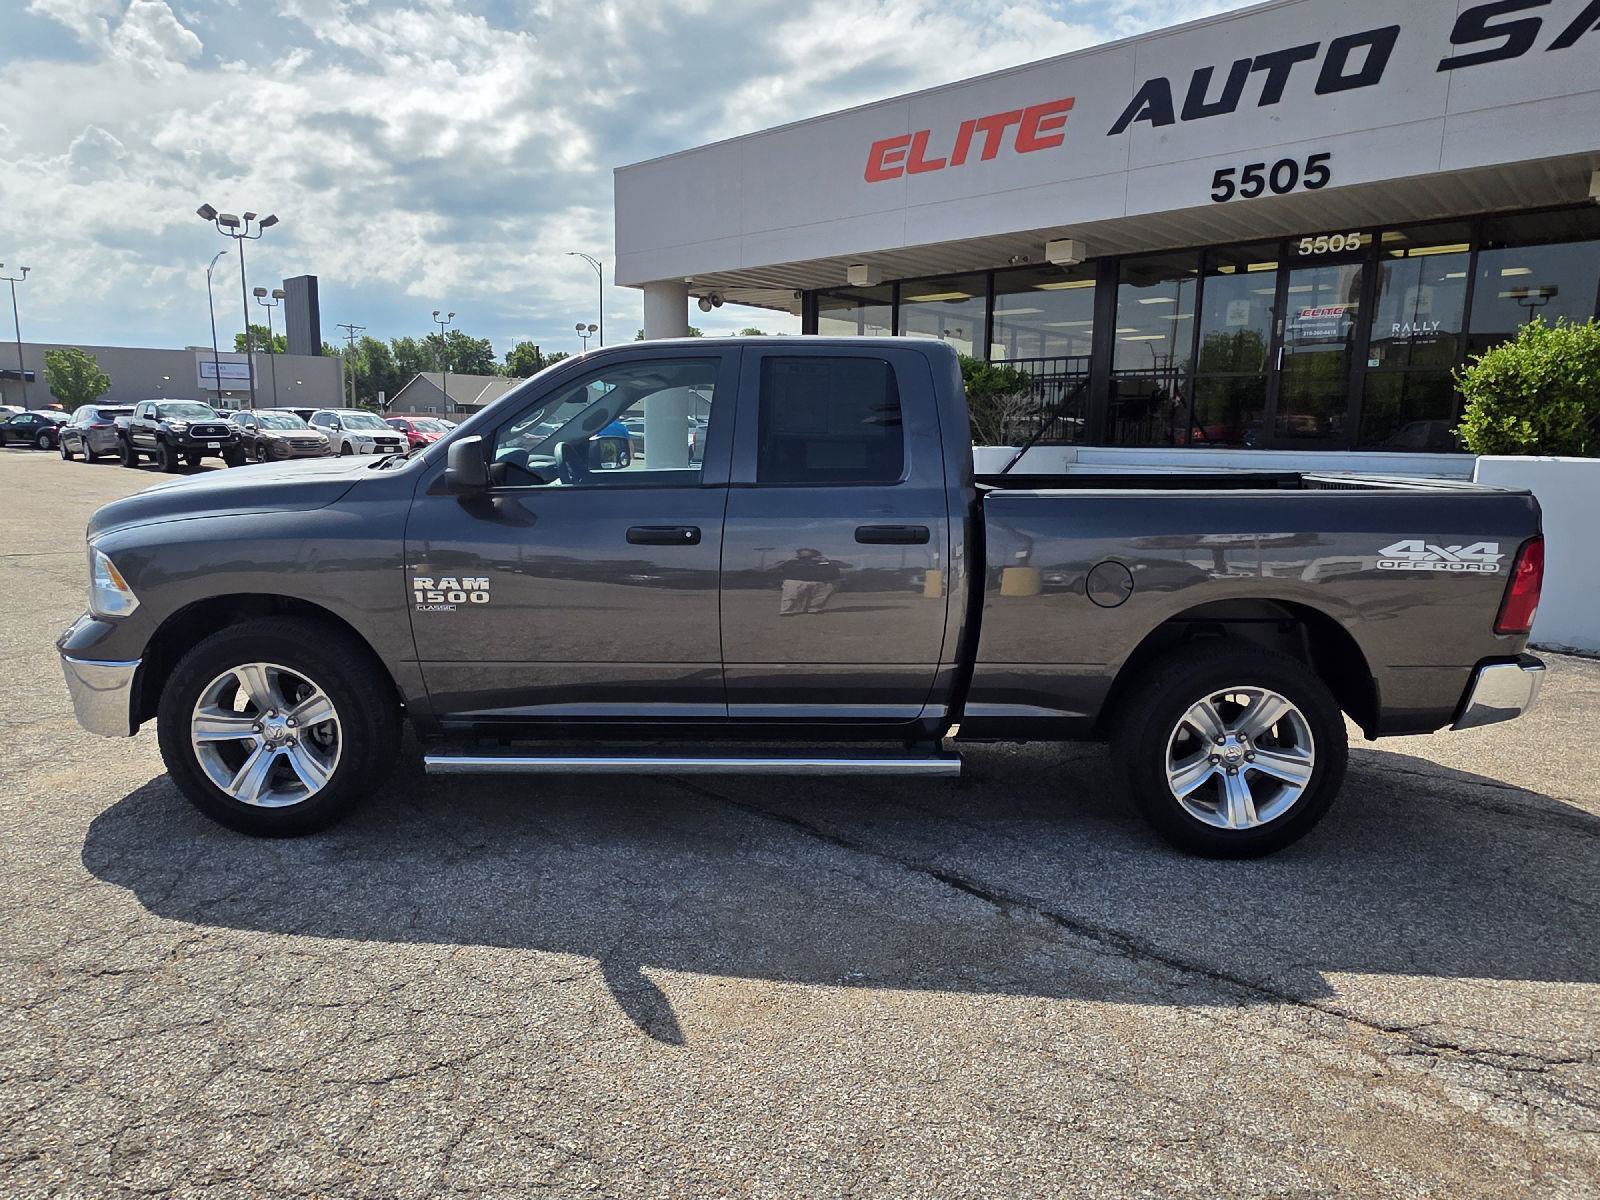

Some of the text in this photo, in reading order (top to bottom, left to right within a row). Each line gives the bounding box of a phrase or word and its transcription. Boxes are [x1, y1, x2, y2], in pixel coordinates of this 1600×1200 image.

[864, 96, 1075, 183] ELITE
[1106, 24, 1400, 137] AUTO
[1210, 152, 1332, 203] 5505
[1298, 232, 1361, 256] 5505
[1301, 306, 1344, 318] ELITE
[1391, 321, 1441, 333] RALLY
[1379, 561, 1498, 572] OFF ROAD
[413, 577, 490, 590] RAM
[413, 591, 490, 604] 1500
